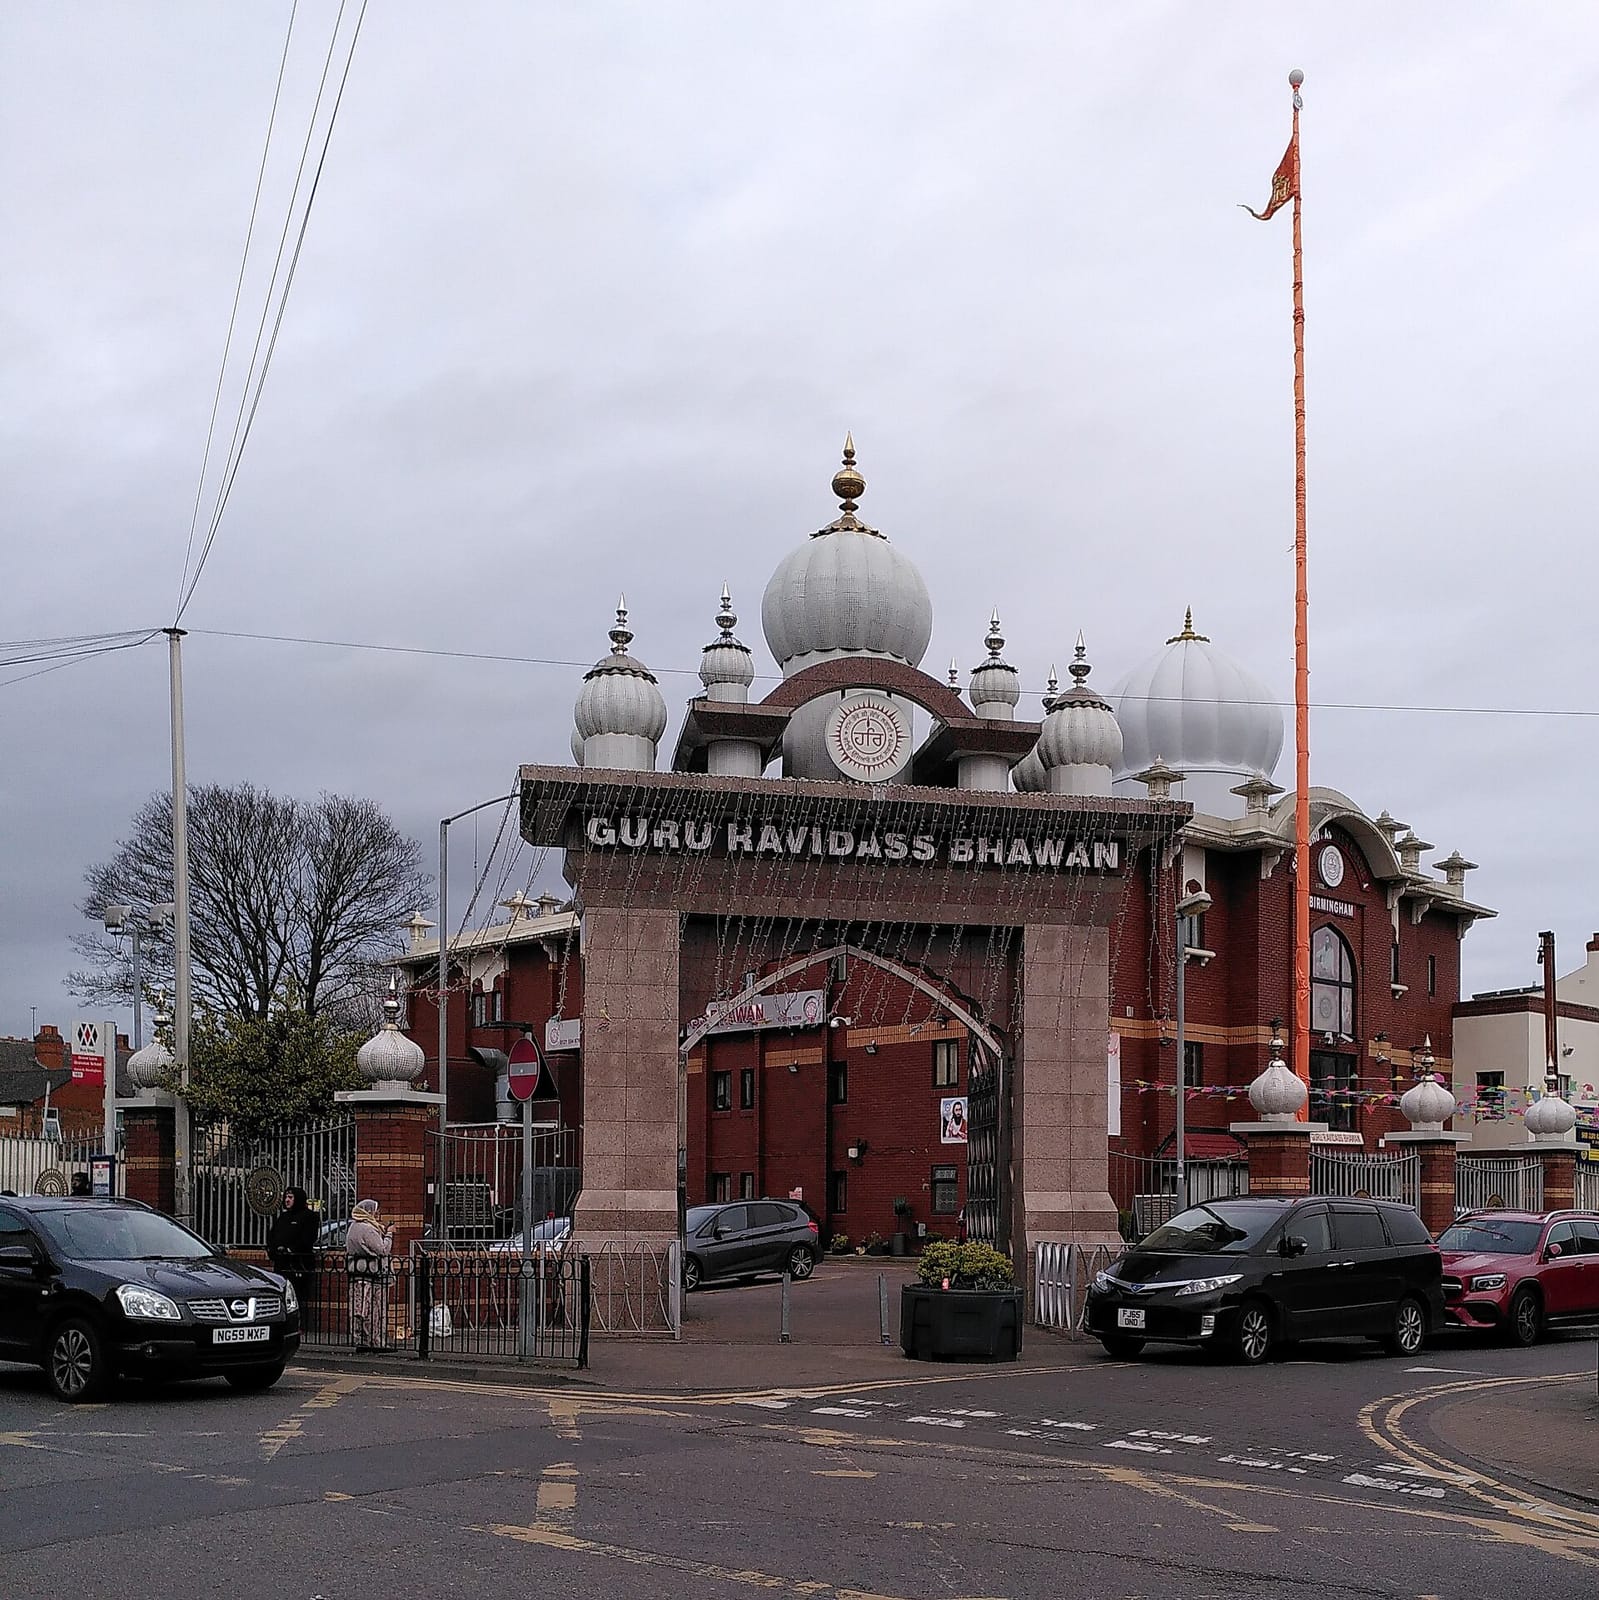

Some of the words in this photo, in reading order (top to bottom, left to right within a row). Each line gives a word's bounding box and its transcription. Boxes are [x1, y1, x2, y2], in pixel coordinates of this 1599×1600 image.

[587, 817, 712, 850] GURU
[728, 822, 936, 861] RAVIDASS
[951, 837, 1119, 869] BHAWAN
[1309, 895, 1354, 918] BIRMINGHAM
[217, 1329, 245, 1342] NG59
